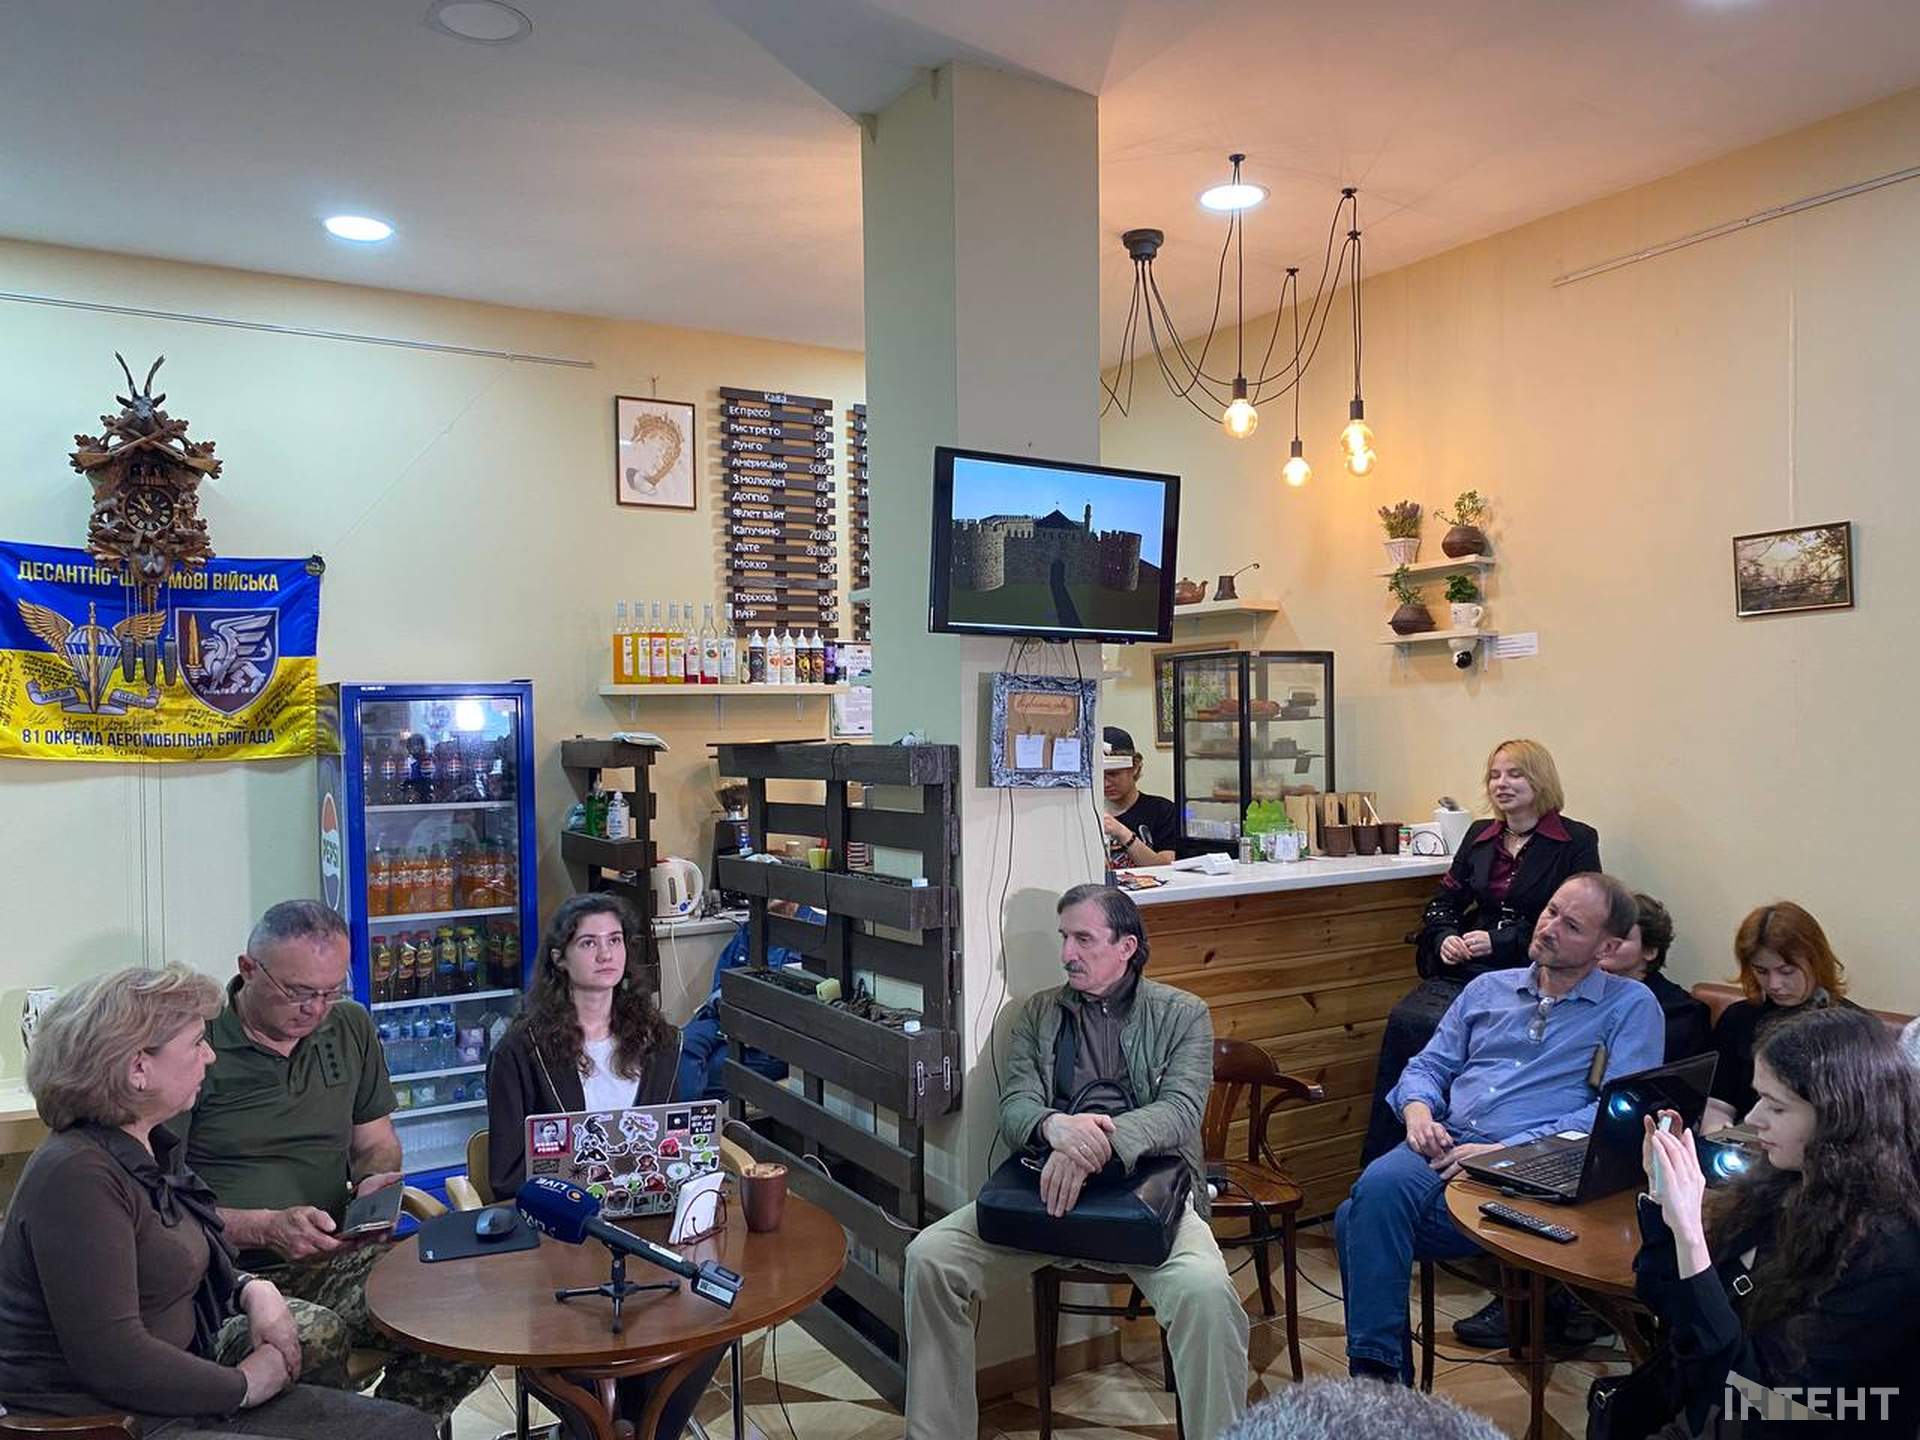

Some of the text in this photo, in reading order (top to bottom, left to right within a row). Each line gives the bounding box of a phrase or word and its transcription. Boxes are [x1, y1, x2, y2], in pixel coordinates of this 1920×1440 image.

[815, 431, 828, 442] 50
[732, 440, 829, 458] Лунго 50
[815, 497, 828, 508] 65
[816, 514, 829, 525] 75
[819, 562, 835, 574] 120
[17, 560, 279, 592] ДЕСАНТНО-ШМОВІ ВІЙСЬКА
[22, 728, 276, 749] 81 ОКРЕМА АЕРОМОБІЛЬНА БРИГАДА
